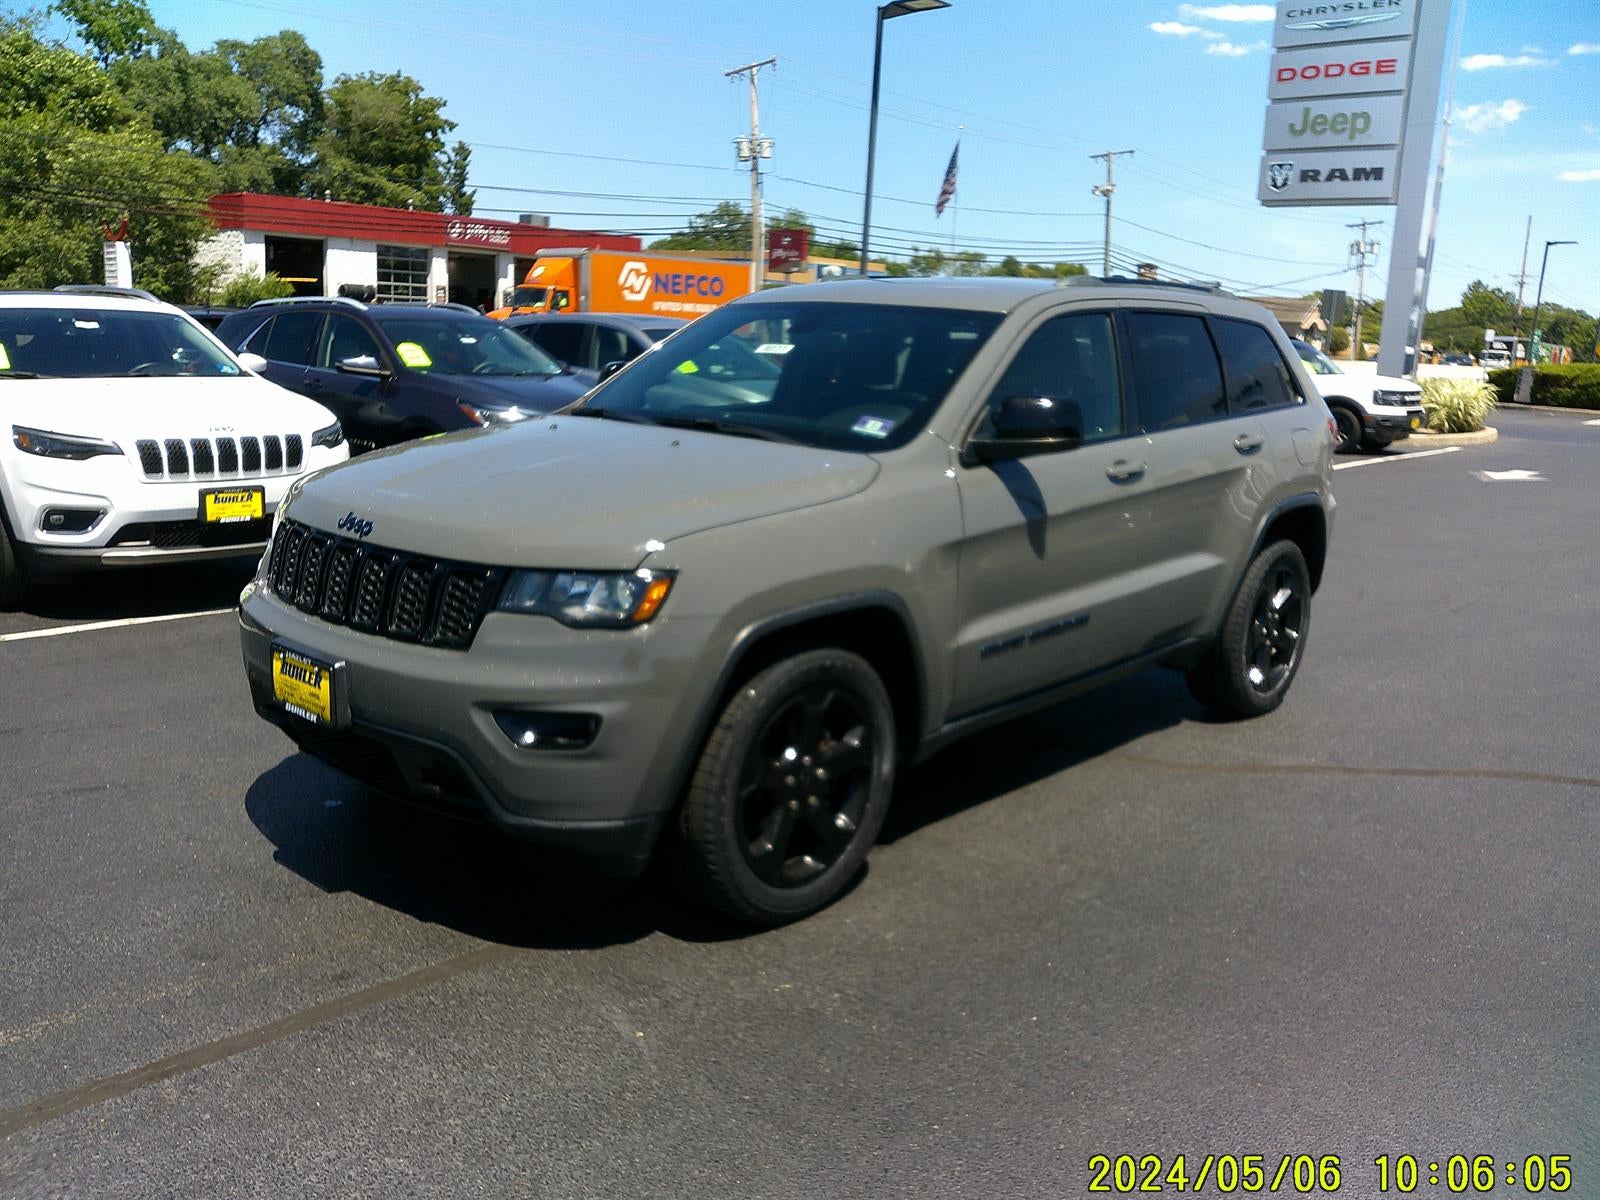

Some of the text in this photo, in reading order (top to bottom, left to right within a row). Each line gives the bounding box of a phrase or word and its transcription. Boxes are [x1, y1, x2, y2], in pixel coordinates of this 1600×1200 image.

[1286, 0, 1400, 18] CHRYSLER
[1276, 58, 1398, 83] DODGE
[1288, 106, 1372, 140] Jeep
[1300, 166, 1385, 184] RAM
[653, 271, 725, 297] NEFCO
[337, 511, 375, 539] Jeep
